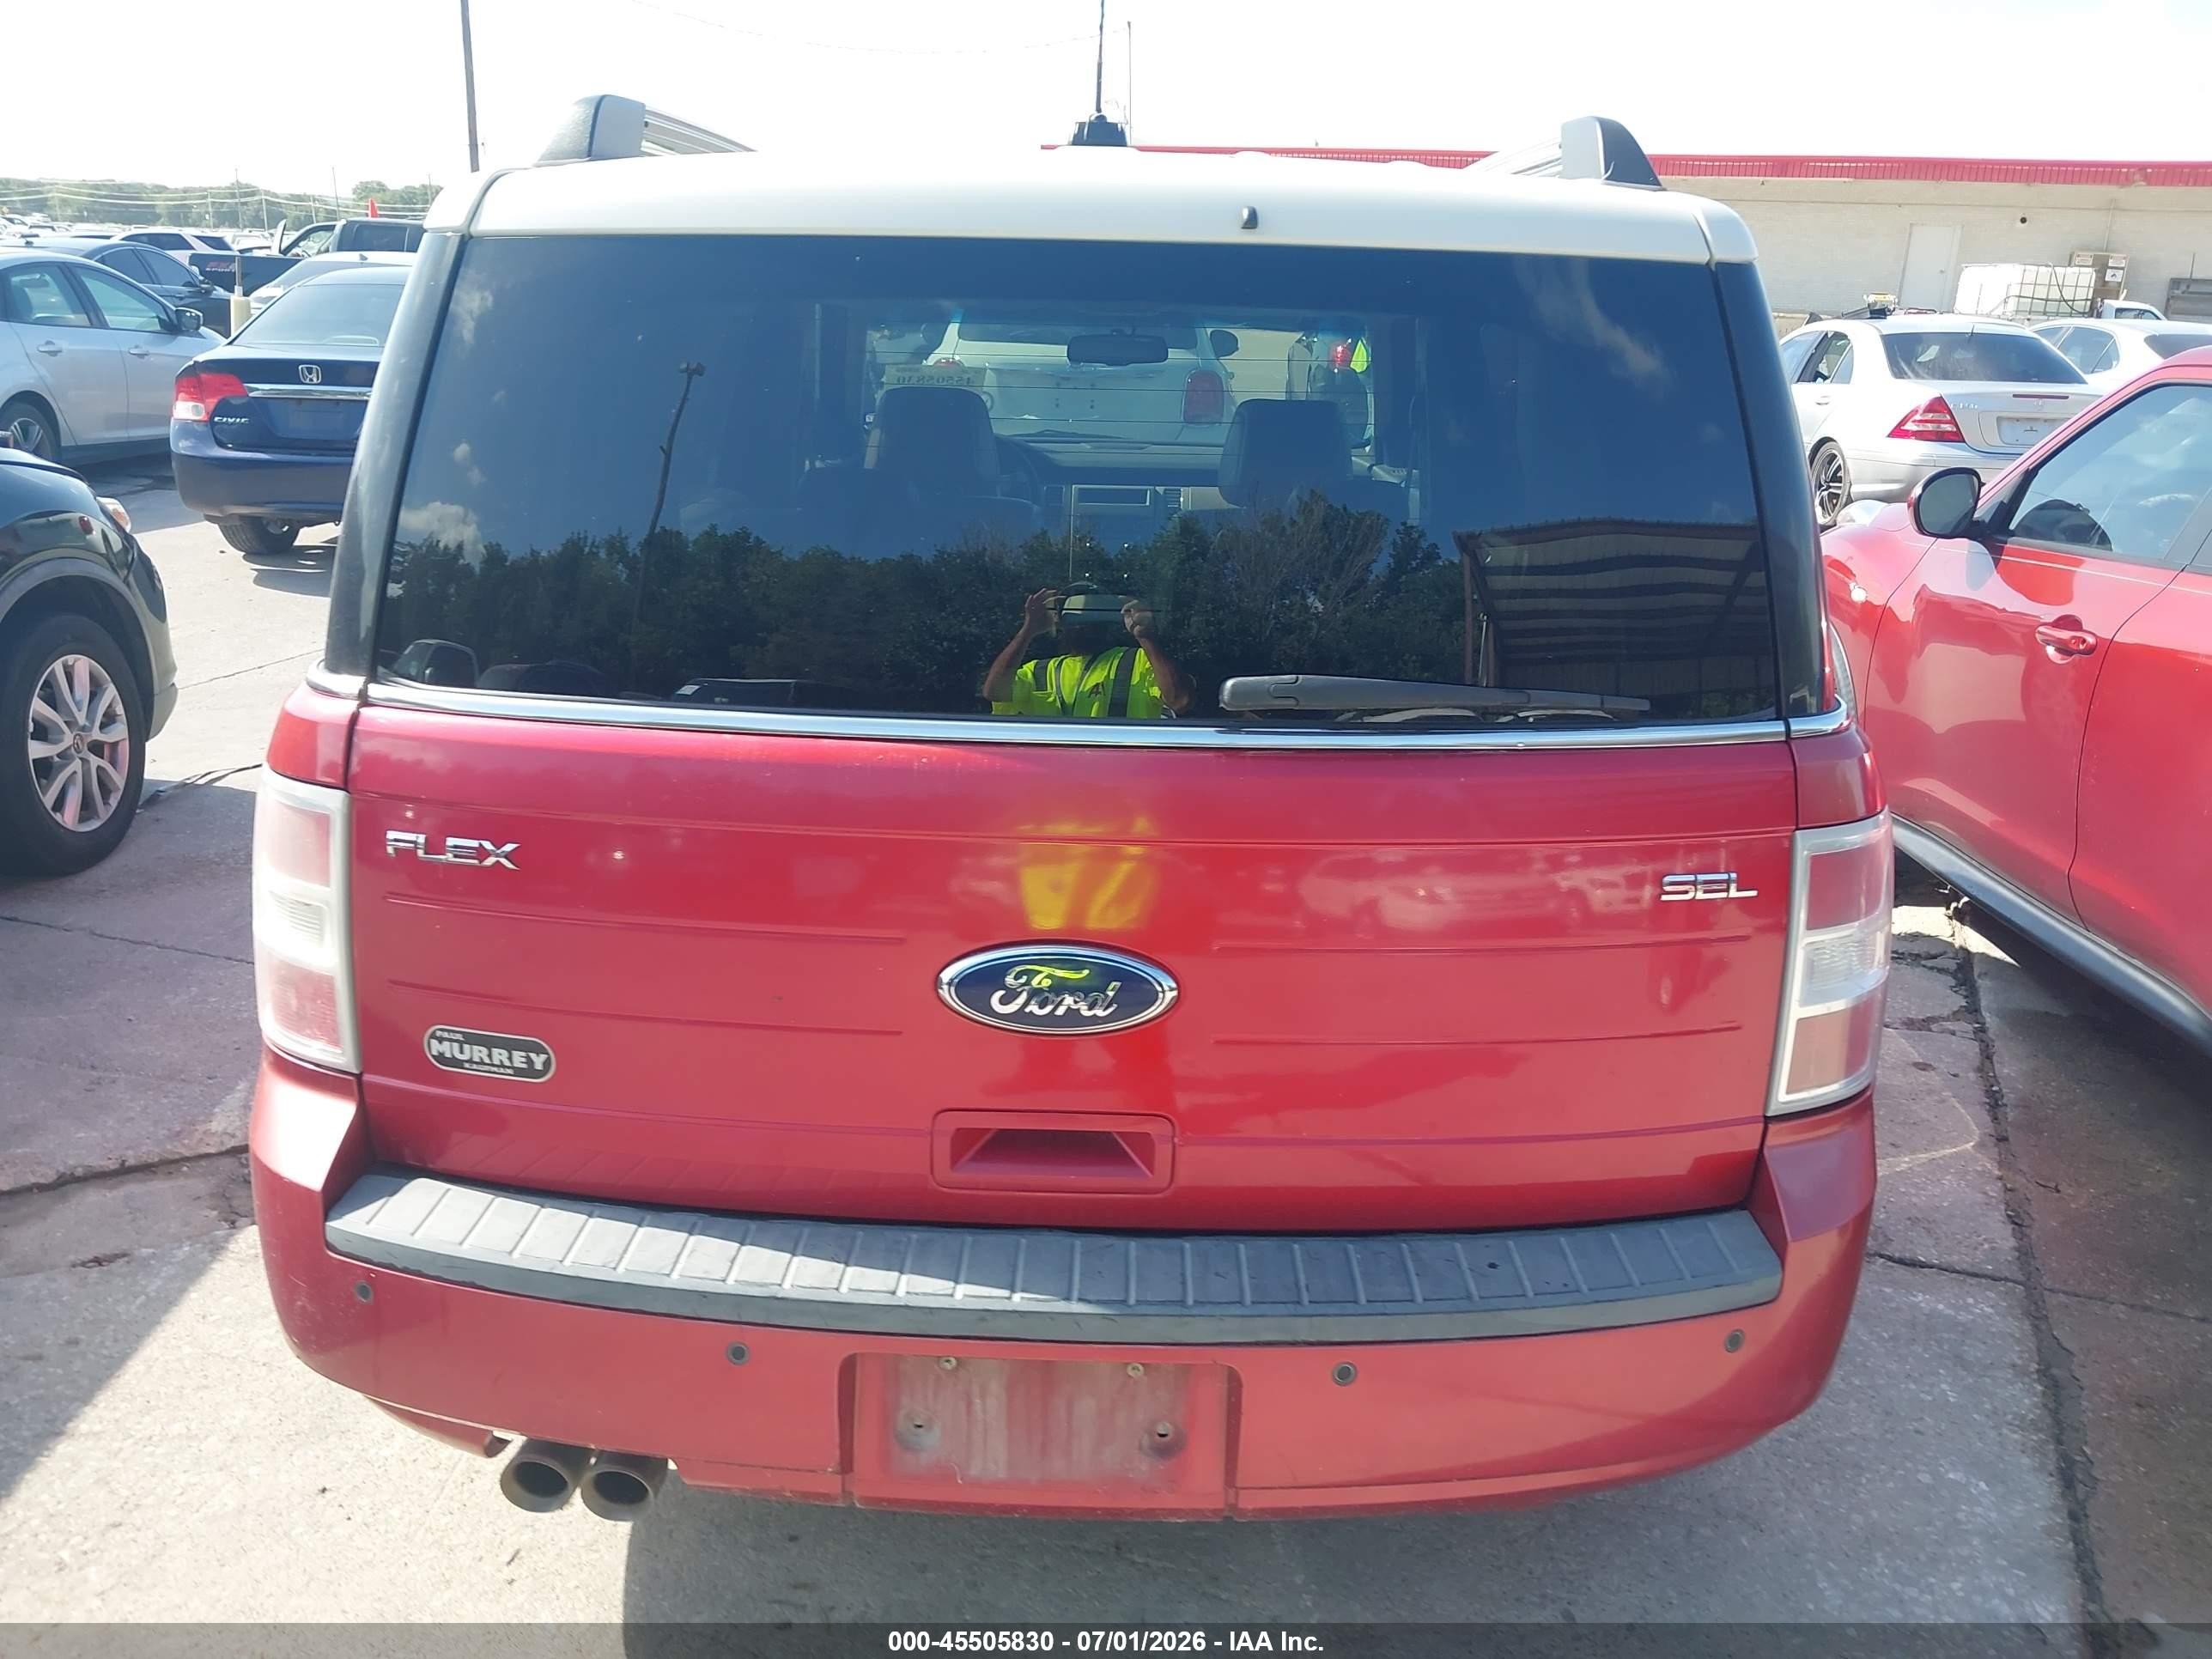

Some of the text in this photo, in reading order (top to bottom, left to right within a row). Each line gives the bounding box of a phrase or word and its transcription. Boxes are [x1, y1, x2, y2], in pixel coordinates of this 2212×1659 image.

[386, 830, 521, 871] FLEX
[1660, 872, 1759, 901] SEL
[989, 963, 1122, 1018] Ford
[429, 1039, 550, 1071] MURREY
